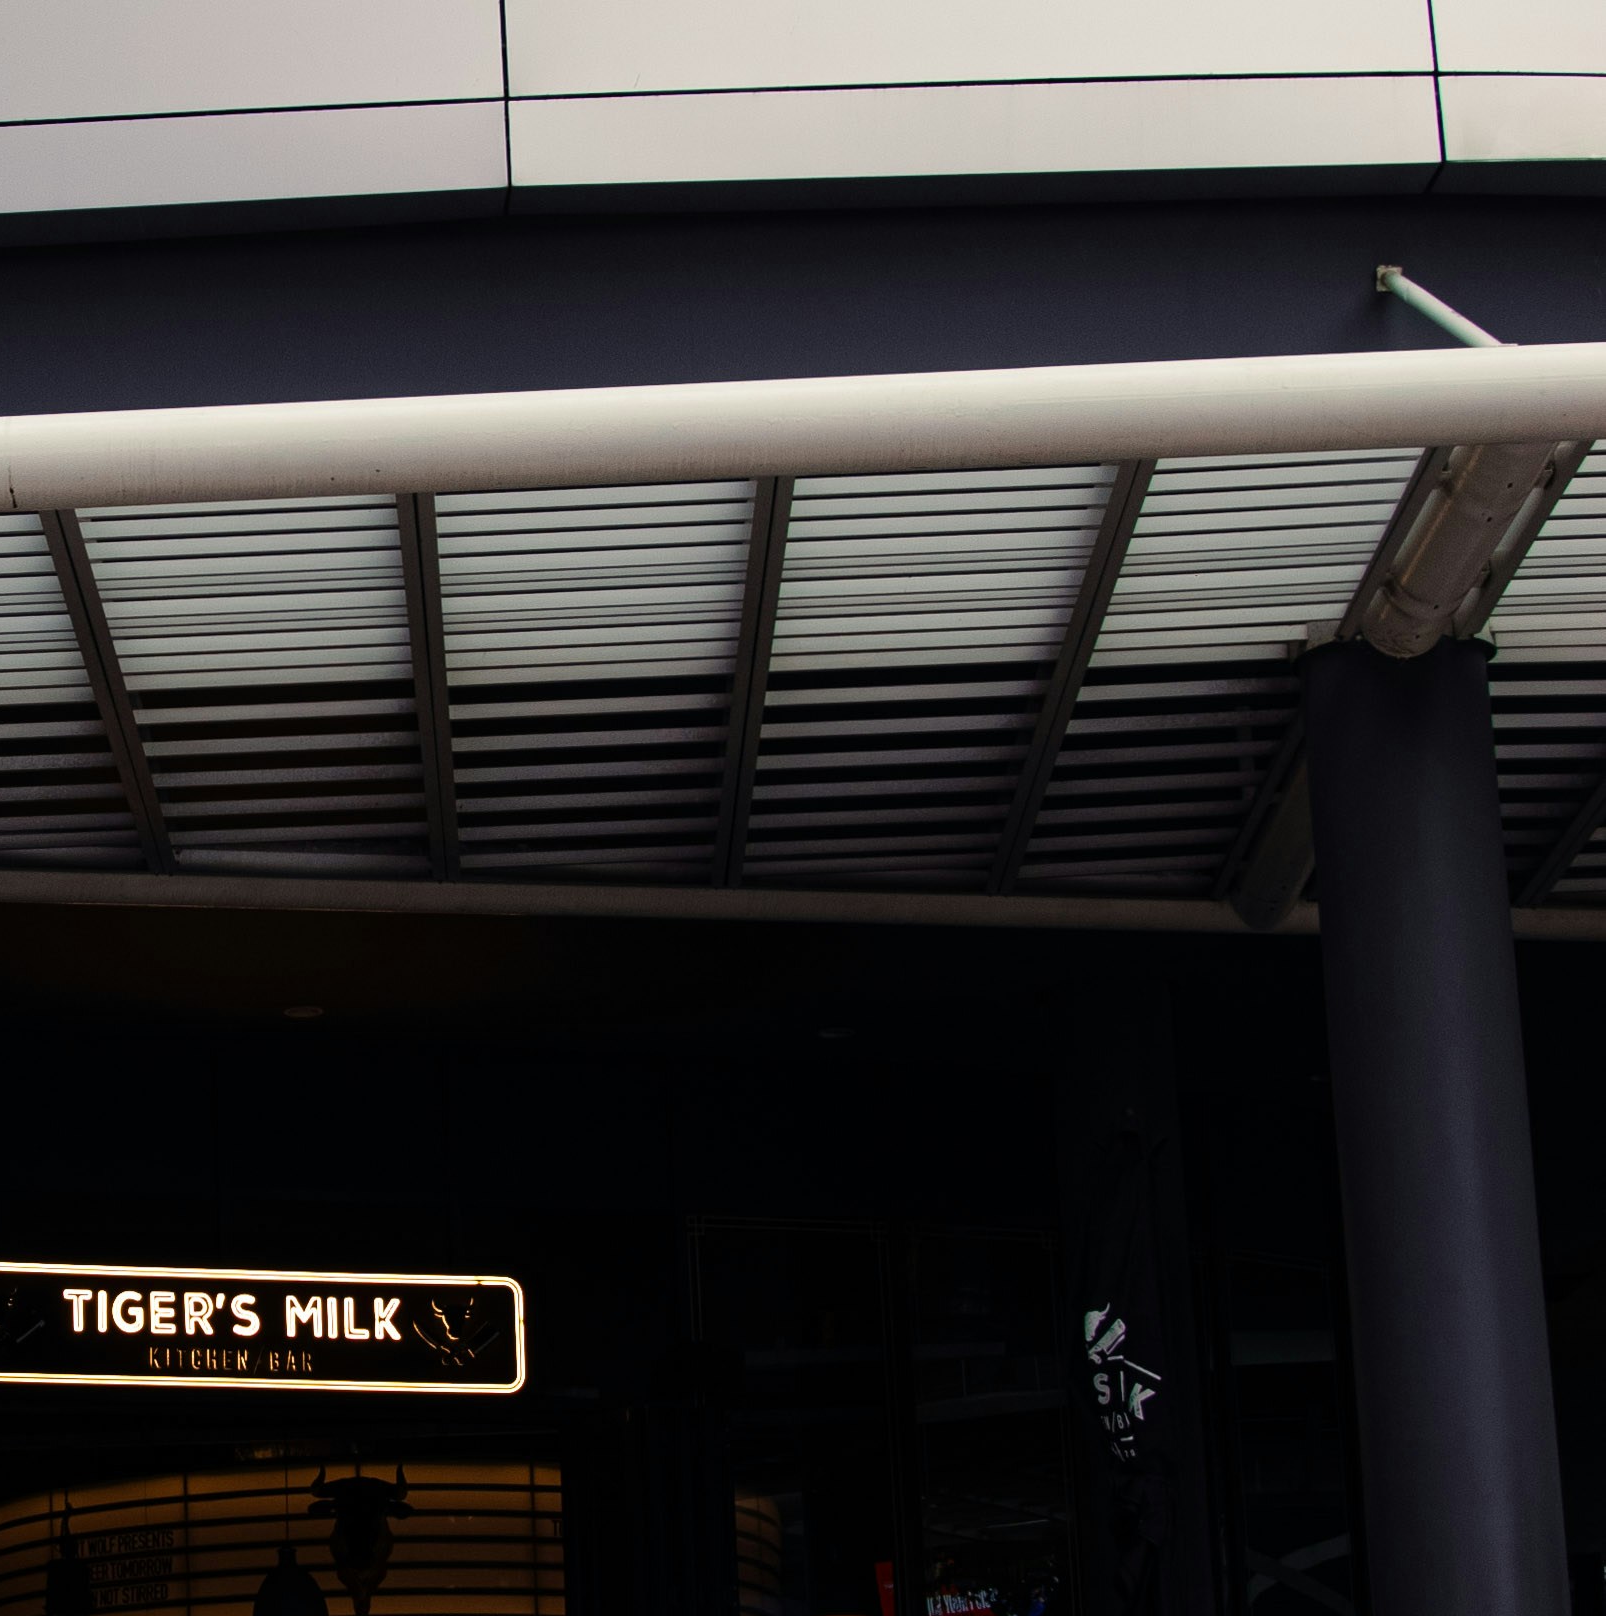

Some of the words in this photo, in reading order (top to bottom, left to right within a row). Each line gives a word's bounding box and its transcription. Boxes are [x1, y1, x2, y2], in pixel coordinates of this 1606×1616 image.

[63, 1288, 261, 1337] TIGER'S
[285, 1294, 402, 1341] MILK
[118, 1531, 174, 1552] PRESENTS
[110, 1556, 173, 1580] TOMORROW
[121, 1583, 168, 1604] STIRRED
